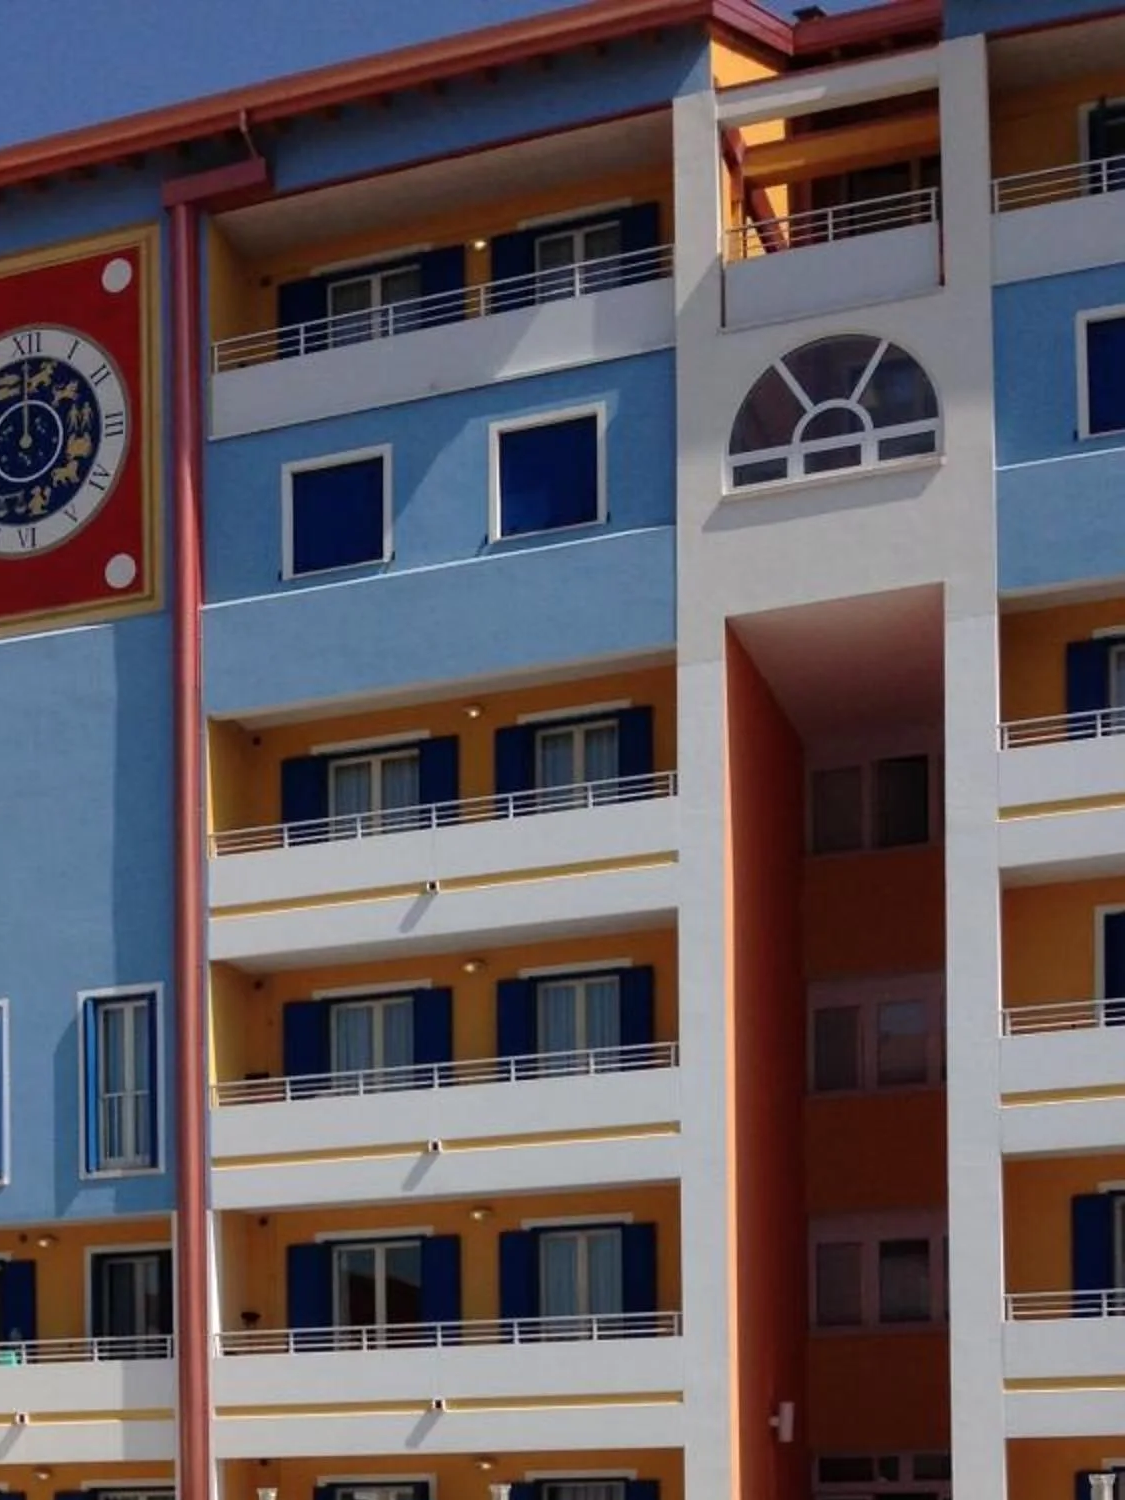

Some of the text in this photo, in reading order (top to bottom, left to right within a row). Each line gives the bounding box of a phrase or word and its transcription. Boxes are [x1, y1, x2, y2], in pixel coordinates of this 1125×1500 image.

[12, 332, 42, 356] XII
[90, 363, 111, 386] II
[105, 411, 124, 437] III
[17, 527, 37, 549] VI
